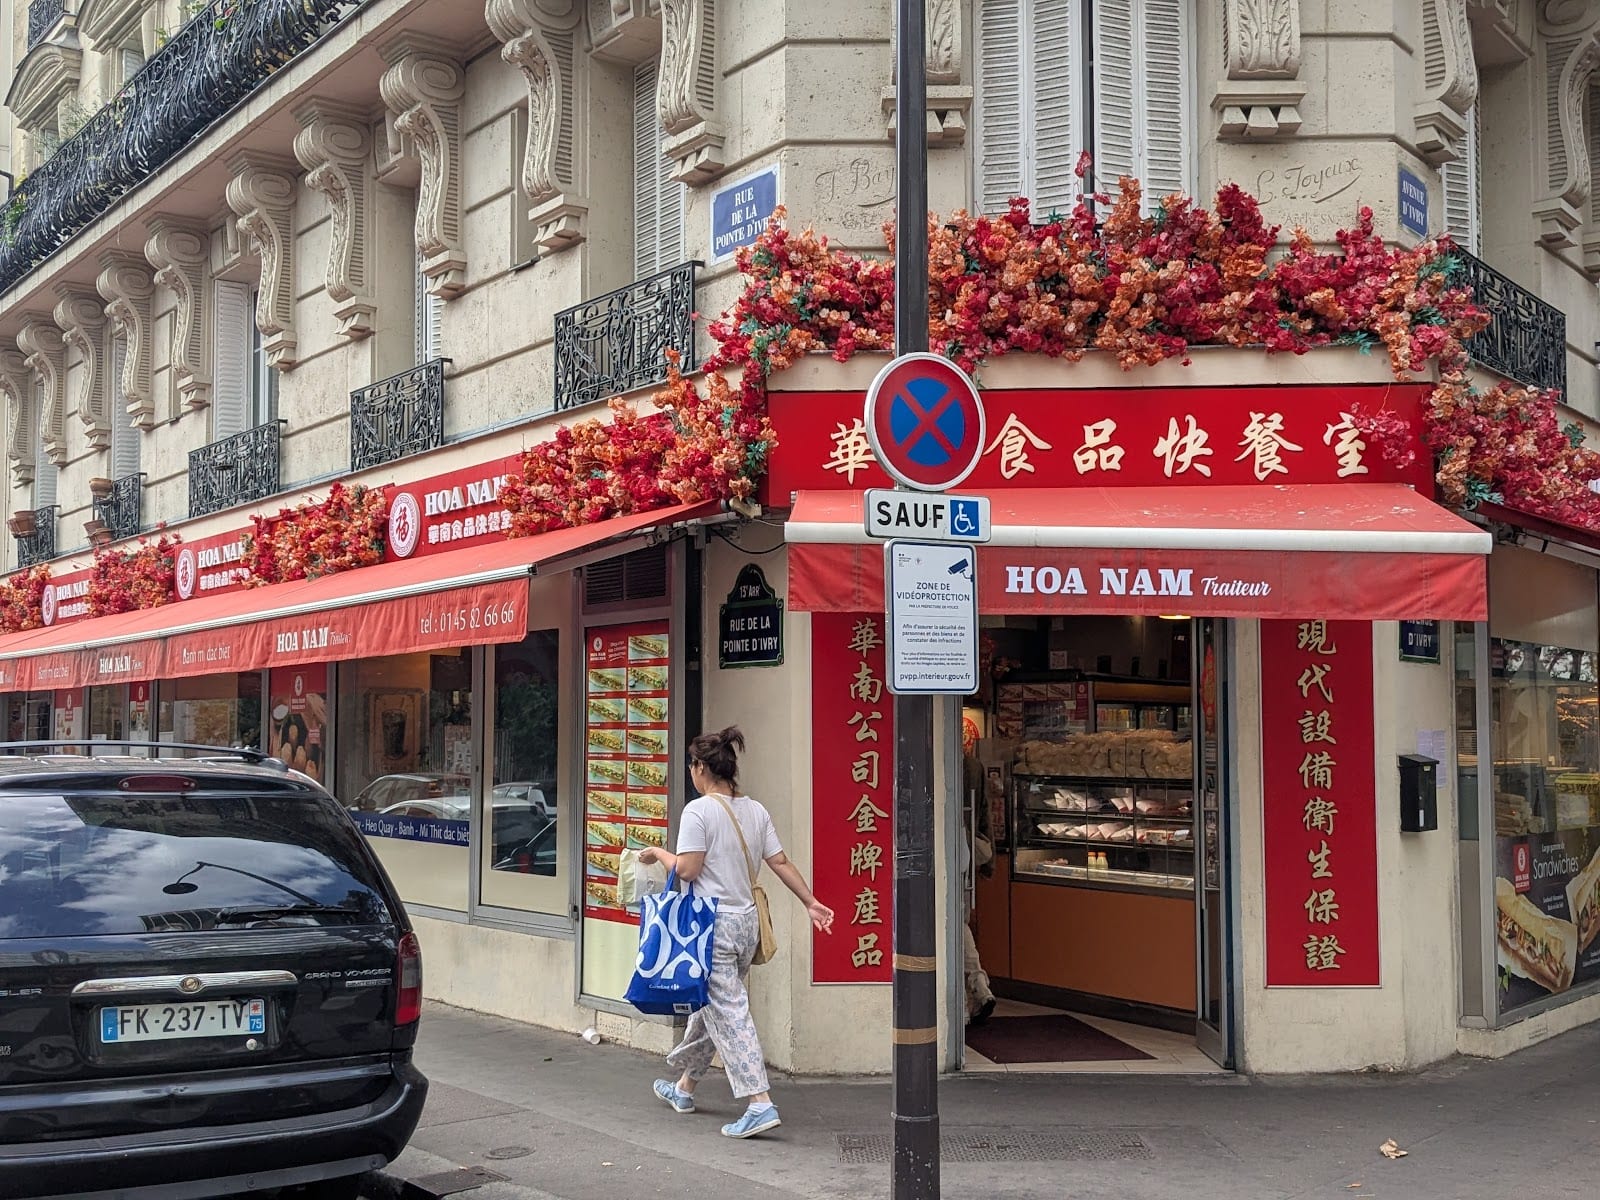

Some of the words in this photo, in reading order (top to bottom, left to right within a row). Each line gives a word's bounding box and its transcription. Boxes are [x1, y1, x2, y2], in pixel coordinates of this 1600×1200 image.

[734, 187, 754, 207] RUE
[1402, 180, 1425, 206] AVENUE
[731, 209, 743, 226] DE
[745, 203, 757, 220] LA
[1402, 200, 1425, 227] D'IVRY
[715, 226, 745, 250] POINTE
[747, 216, 771, 237] D'IVR
[822, 409, 1369, 485] 華食品快餐室
[425, 487, 465, 516] HOA
[876, 500, 945, 529] SAUF
[198, 547, 221, 569] HOA
[916, 581, 939, 591] ZONE
[940, 583, 951, 591] DE
[1005, 565, 1088, 595] HOA
[1099, 568, 1194, 597] NAM
[1200, 575, 1272, 597] Traiteur
[56, 583, 72, 601] HOA
[896, 591, 970, 601] VIDÉOPROTECTION
[420, 611, 433, 634] tel
[454, 609, 467, 631] 45
[469, 607, 481, 629] 82
[484, 603, 499, 627] 66
[501, 600, 515, 624] 66
[730, 618, 746, 632] RUE
[747, 616, 759, 630] DE
[760, 615, 771, 629] LA
[277, 631, 299, 653] HOA
[302, 626, 329, 650] NAM
[723, 639, 750, 653] POINTE
[752, 636, 779, 651] D'IVRY
[1408, 632, 1432, 648] D'IVRY
[99, 658, 113, 674] HOA
[899, 671, 971, 681] pvpp.interieur.gouv.fr
[378, 819, 394, 837] Quay
[1532, 853, 1579, 880] Sandwiches
[305, 971, 342, 980] GRAND
[344, 967, 392, 977] VOYAGER
[119, 1003, 246, 1036] FK-237-TV
[250, 1018, 263, 1030] 75
[107, 1027, 114, 1036] F
